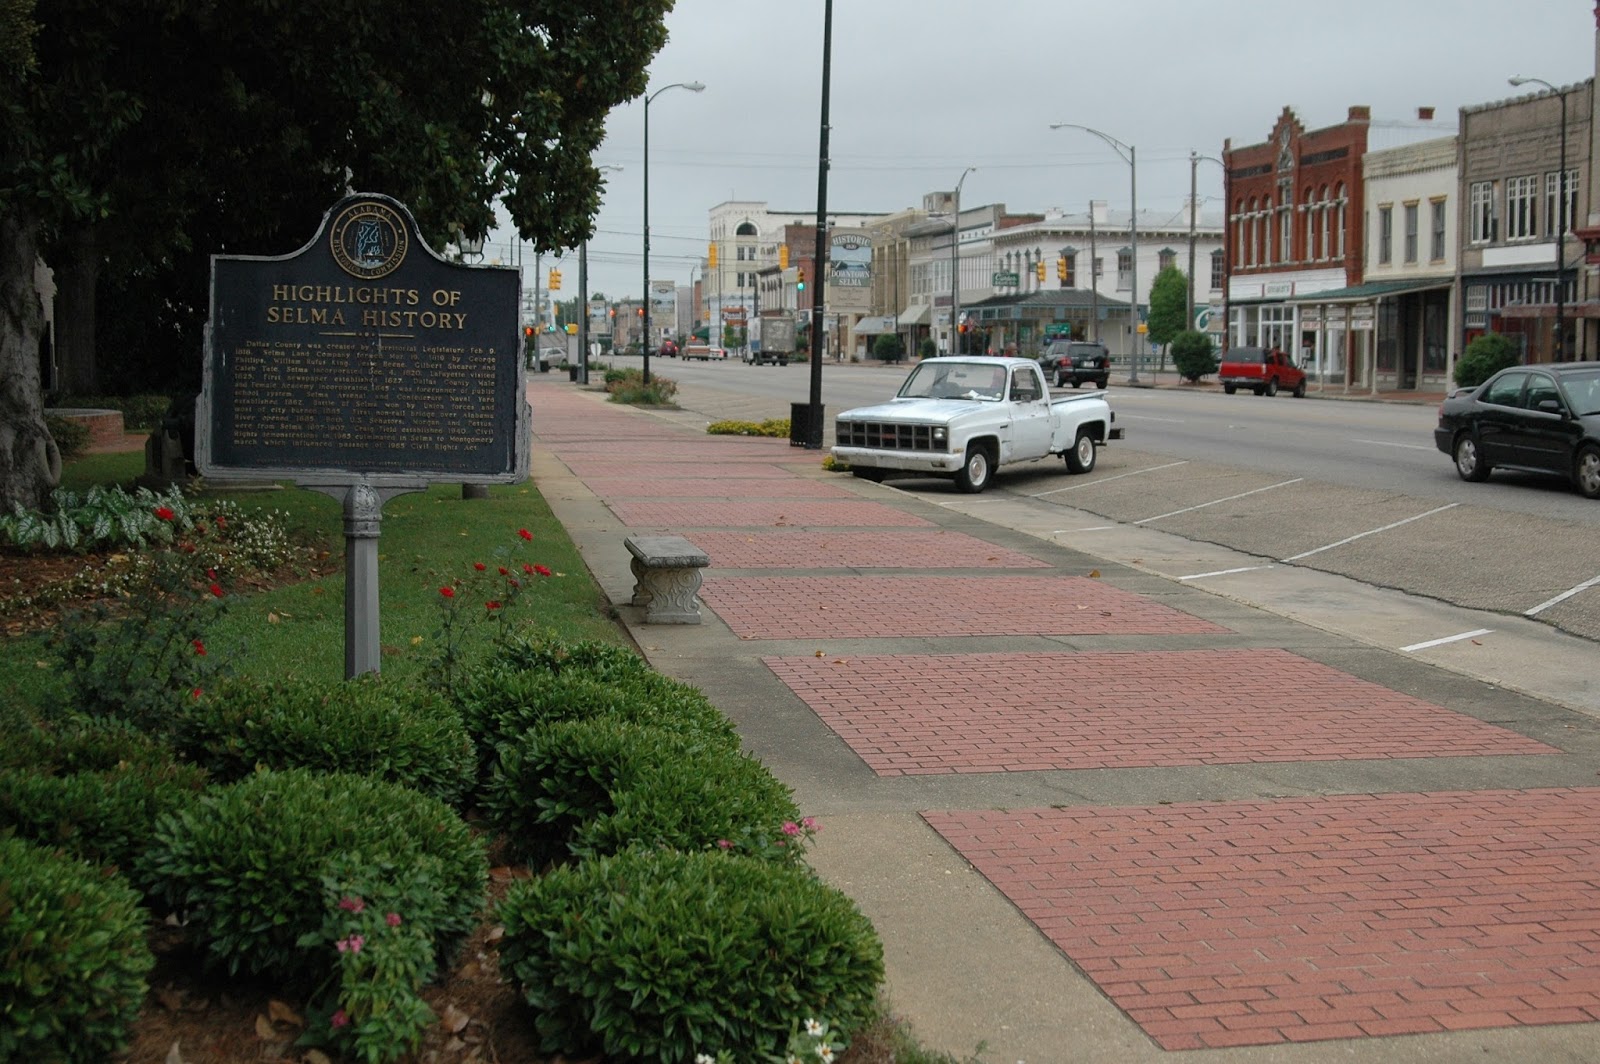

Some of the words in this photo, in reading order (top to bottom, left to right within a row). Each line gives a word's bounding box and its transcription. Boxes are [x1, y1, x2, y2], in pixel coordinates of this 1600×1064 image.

[347, 206, 393, 220] ALABAMA
[832, 234, 871, 246] HISTORIC
[273, 284, 420, 305] HIGHLIGHTS
[432, 290, 462, 306] OF
[267, 306, 346, 326] SELMA
[362, 310, 468, 330] HISTORY
